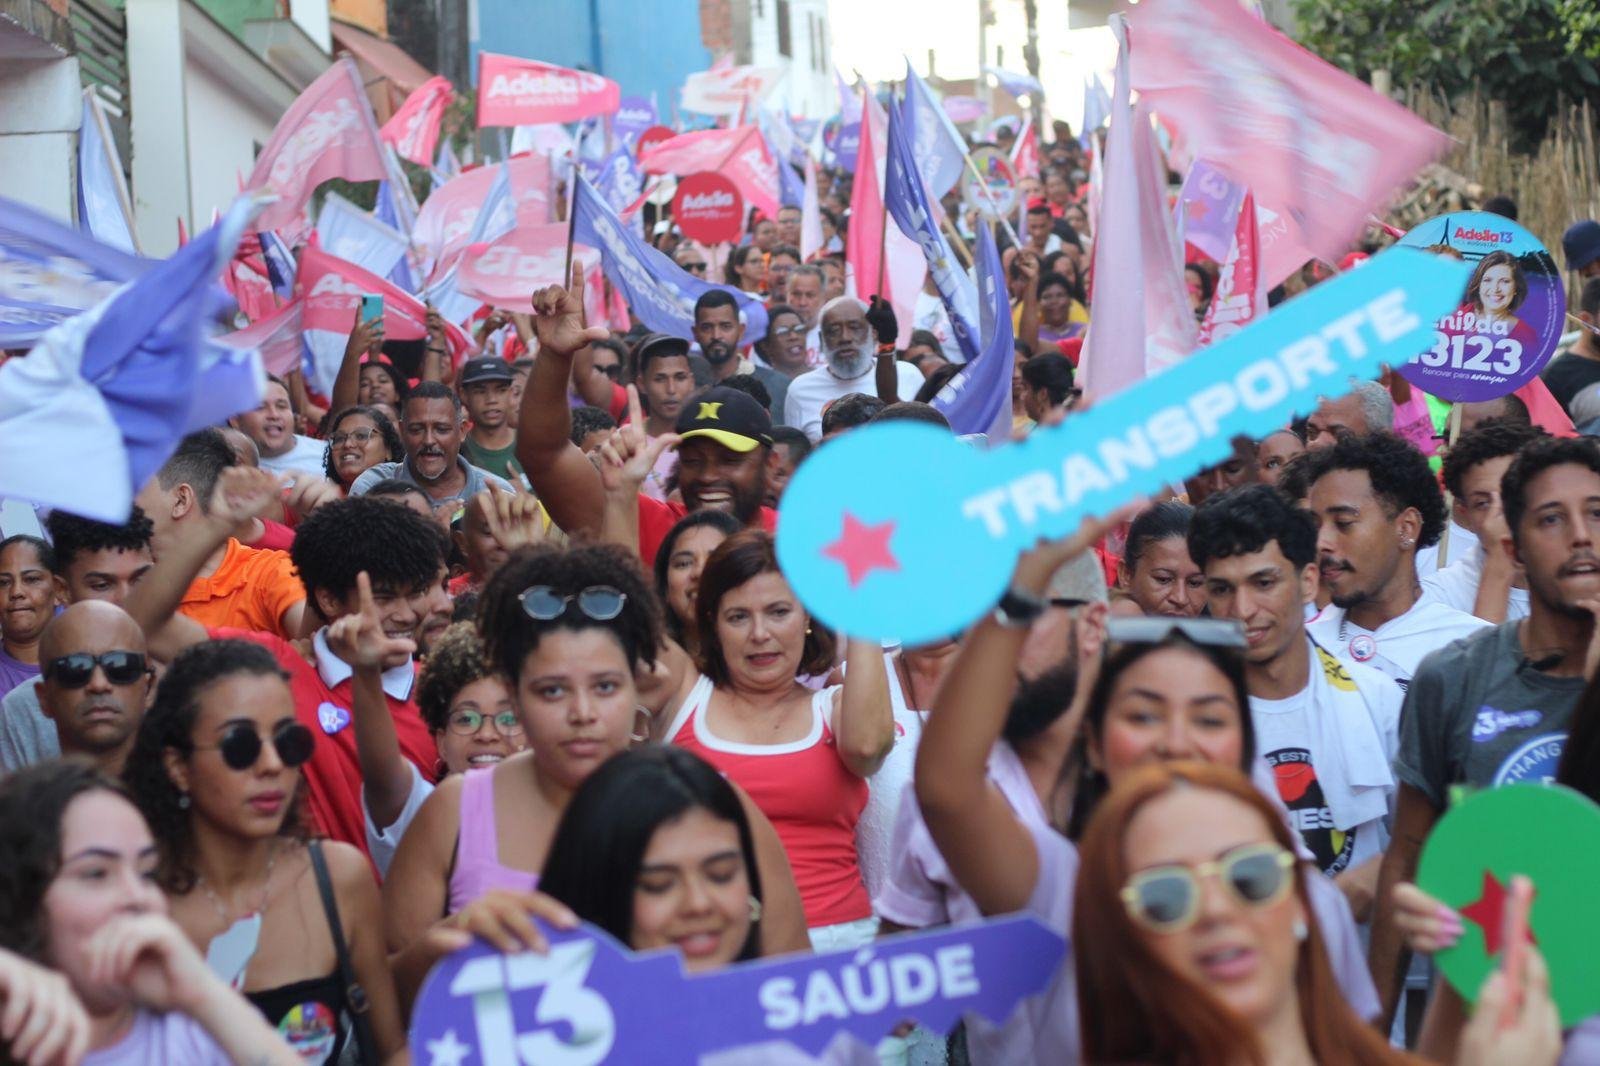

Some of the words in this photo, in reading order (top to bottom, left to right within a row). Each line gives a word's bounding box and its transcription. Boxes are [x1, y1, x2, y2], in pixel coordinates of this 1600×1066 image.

[1433, 310, 1508, 336] nilda
[962, 288, 1421, 538] TRANSPORTE
[450, 938, 617, 1066] 13
[758, 943, 982, 1031] SAÚDE
